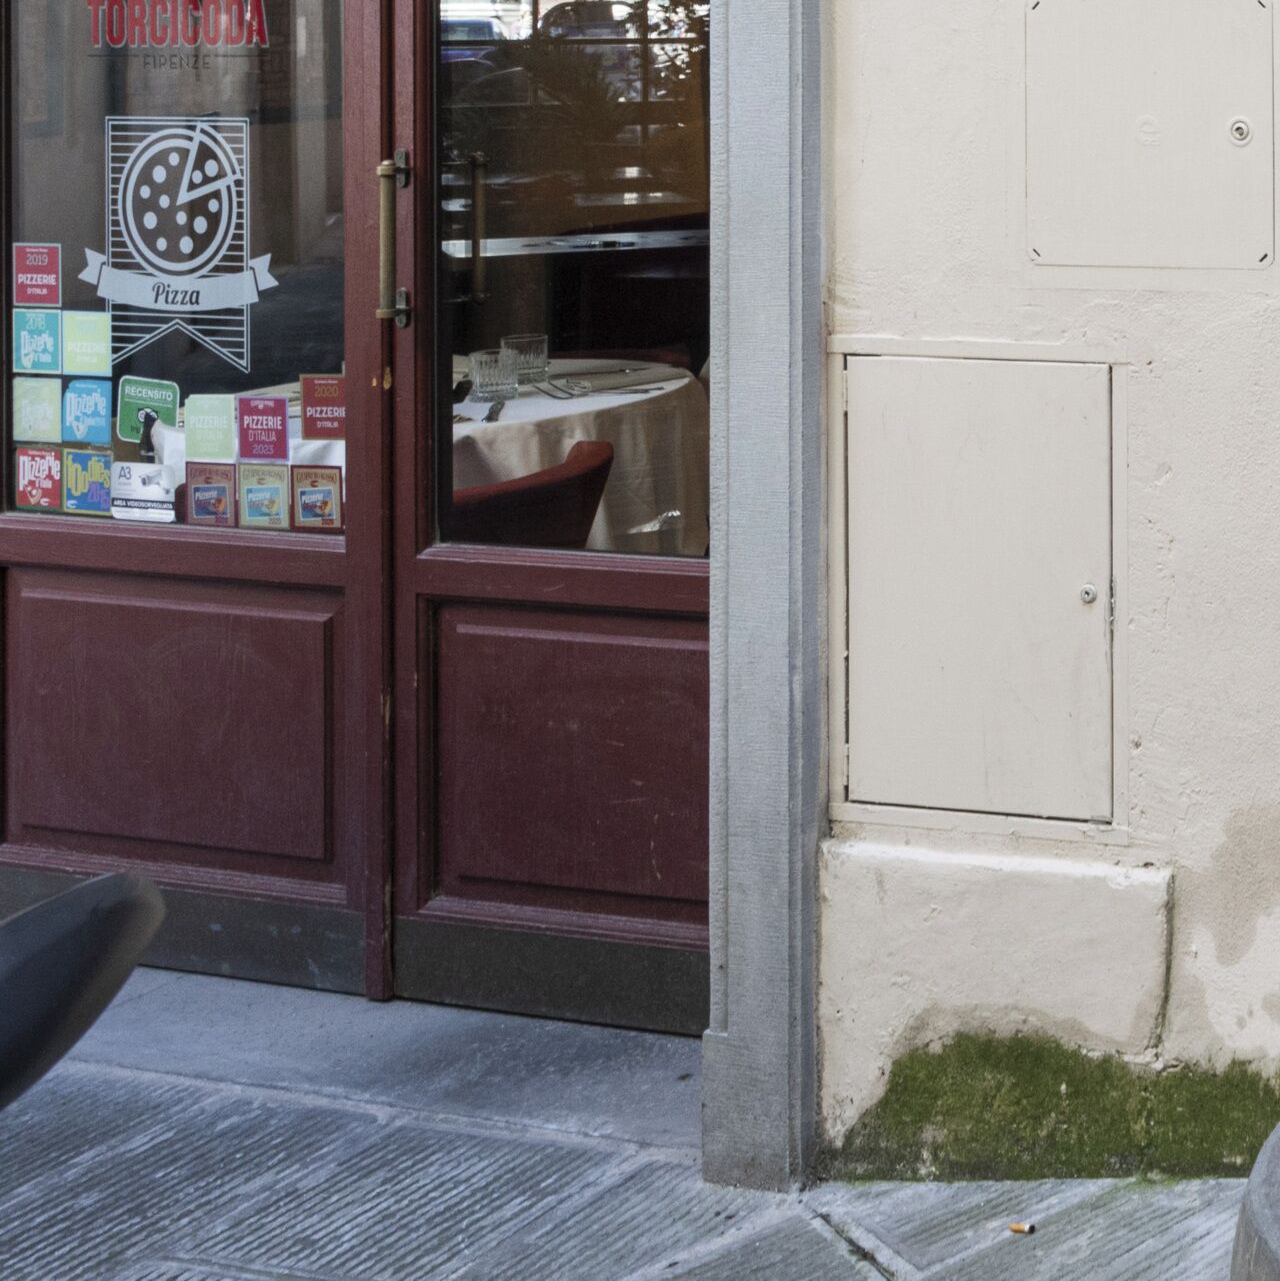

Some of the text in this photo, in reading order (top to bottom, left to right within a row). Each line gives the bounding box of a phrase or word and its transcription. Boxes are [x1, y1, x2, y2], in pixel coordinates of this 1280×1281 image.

[143, 54, 211, 70] FIRENZE
[26, 254, 48, 265] 2019
[18, 274, 56, 285] PIZZERIE
[152, 281, 201, 306] Pizza
[125, 386, 173, 401] RECENSITO
[243, 415, 282, 429] PIZZERIE
[248, 430, 277, 441] D'ITALIA
[118, 466, 132, 479] A3
